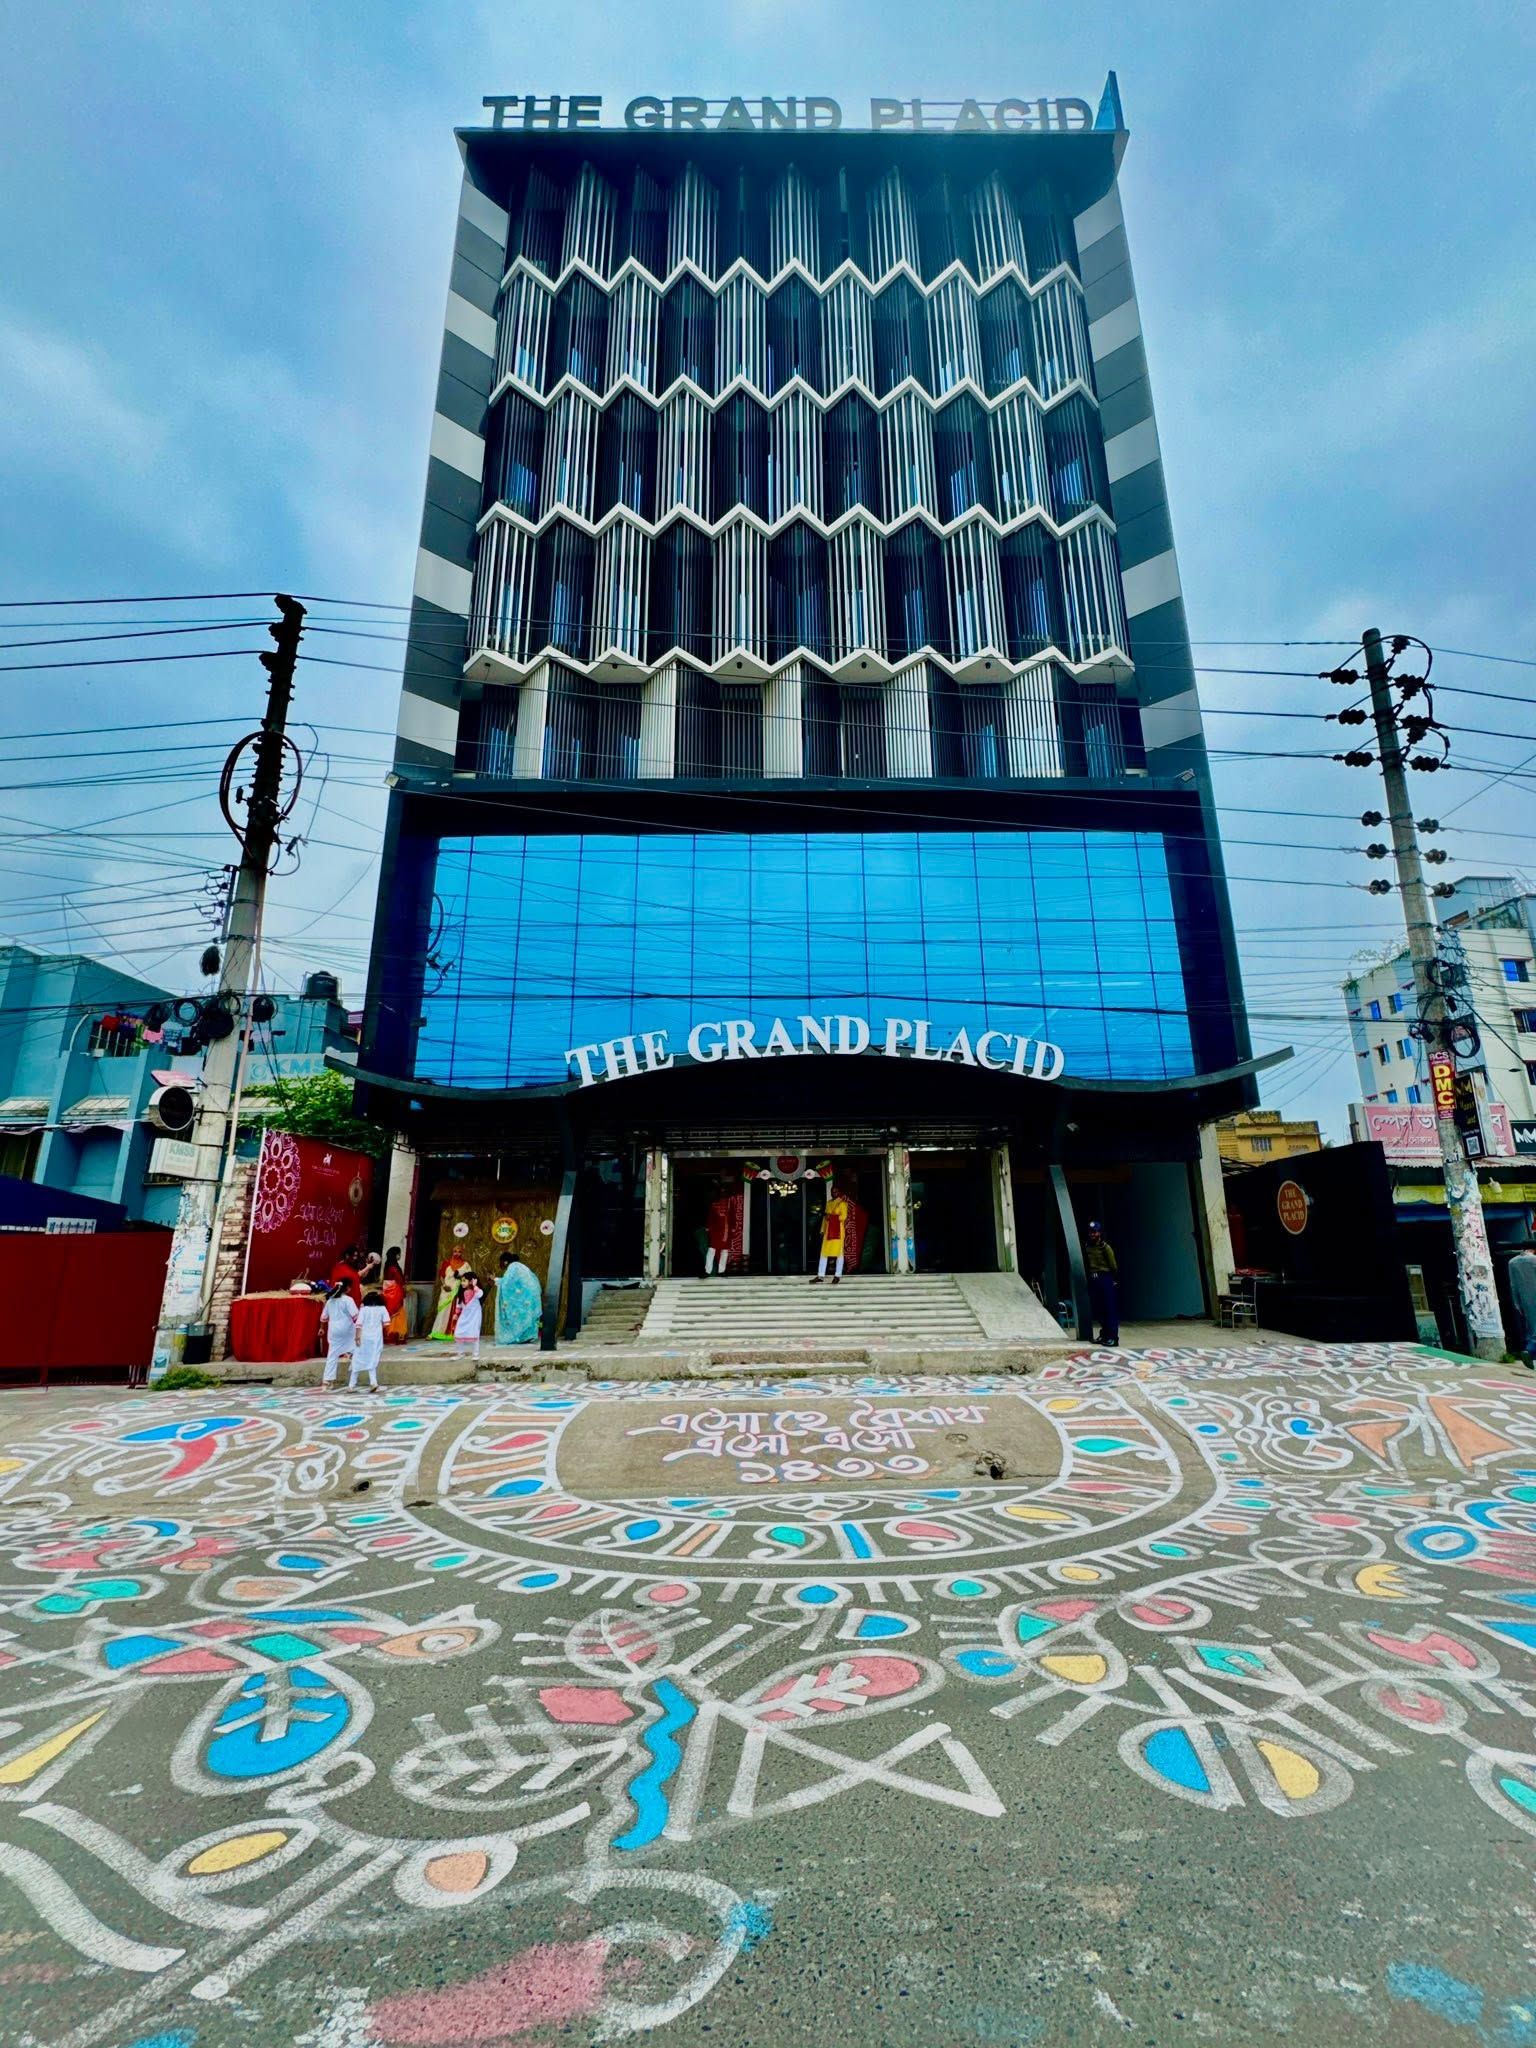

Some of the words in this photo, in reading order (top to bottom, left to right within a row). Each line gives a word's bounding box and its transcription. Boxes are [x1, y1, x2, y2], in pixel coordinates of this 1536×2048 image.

[483, 95, 602, 129] THE
[624, 95, 842, 130] GRAND
[870, 97, 1093, 131] PLACID
[564, 1029, 675, 1089] THE
[687, 1013, 872, 1062] GRAND
[881, 1017, 1065, 1082] PLACID
[1433, 1065, 1454, 1105] DMC
[1281, 1199, 1303, 1210] GRAND
[1283, 1211, 1304, 1220] PLACID
[625, 1407, 770, 1437] এসো
[772, 1410, 840, 1436] হে
[848, 1400, 991, 1430] বৈশাখ
[662, 1433, 790, 1462] এসো
[799, 1428, 938, 1454] এসো
[737, 1454, 930, 1484] ১৪৩৩
